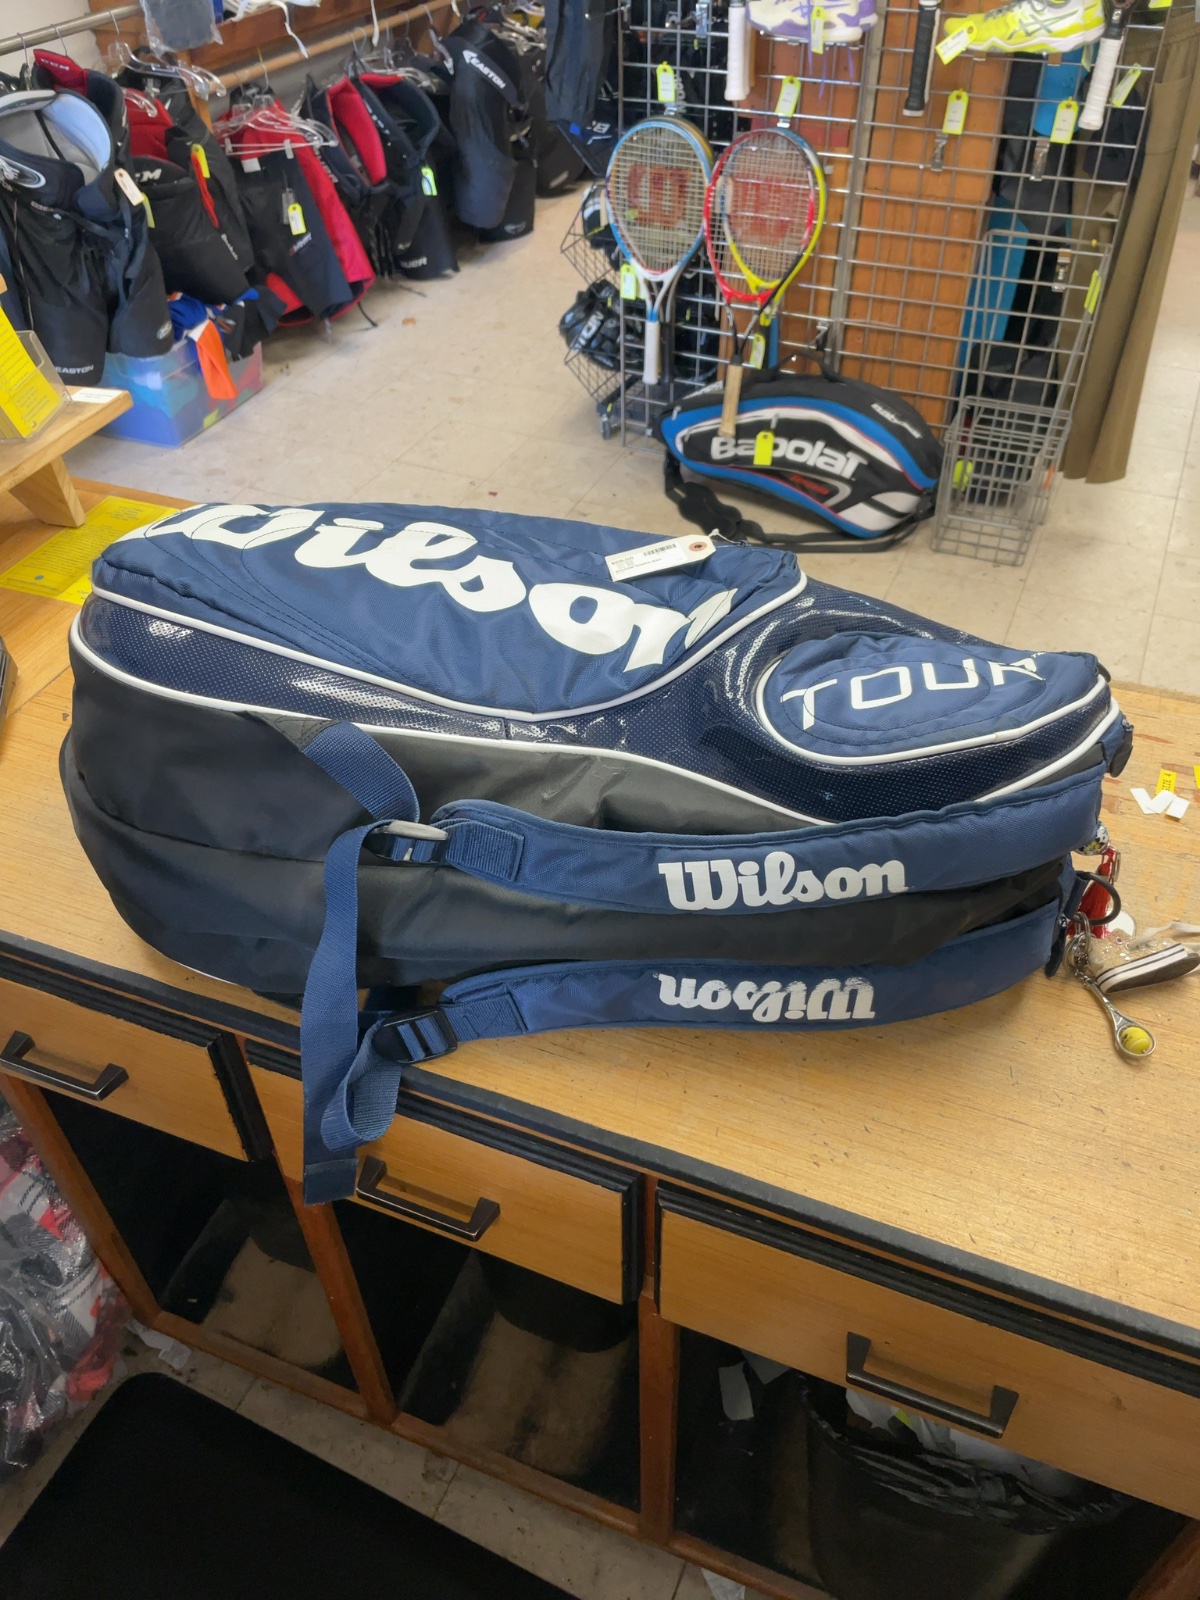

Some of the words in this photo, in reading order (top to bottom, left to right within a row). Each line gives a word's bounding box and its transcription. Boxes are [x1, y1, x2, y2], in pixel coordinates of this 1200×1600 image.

[470, 56, 507, 89] EASTON
[55, 364, 94, 375] EASTON
[658, 851, 908, 911] Wilson
[658, 973, 876, 1023] Wilson
